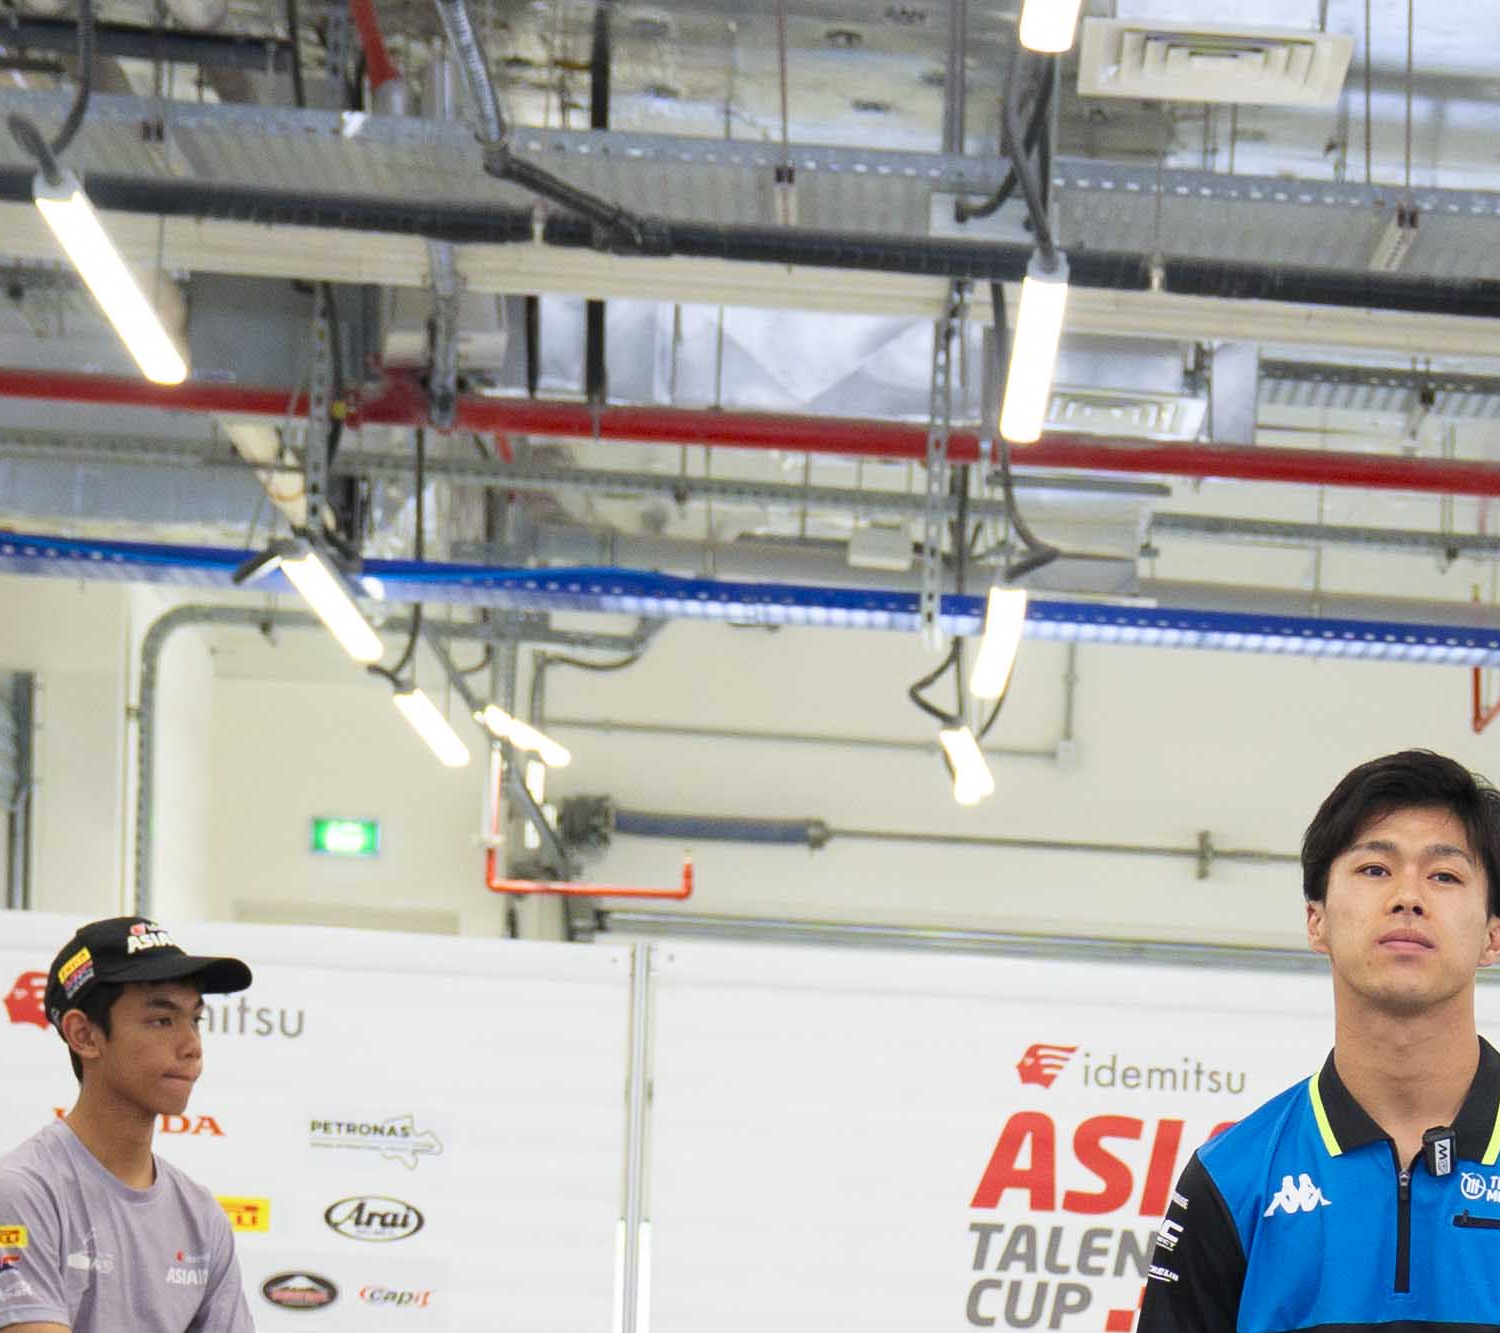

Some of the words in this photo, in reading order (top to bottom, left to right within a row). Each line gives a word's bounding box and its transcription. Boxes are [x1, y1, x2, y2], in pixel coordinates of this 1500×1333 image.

[200, 994, 304, 1038] itsu
[1083, 1053, 1247, 1095] idemitsu
[310, 1120, 411, 1139] PETRONAS
[970, 1111, 1184, 1218] ASI
[340, 1201, 411, 1230] Arai
[968, 1222, 1160, 1279] TALEN
[966, 1281, 1092, 1331] CUP
